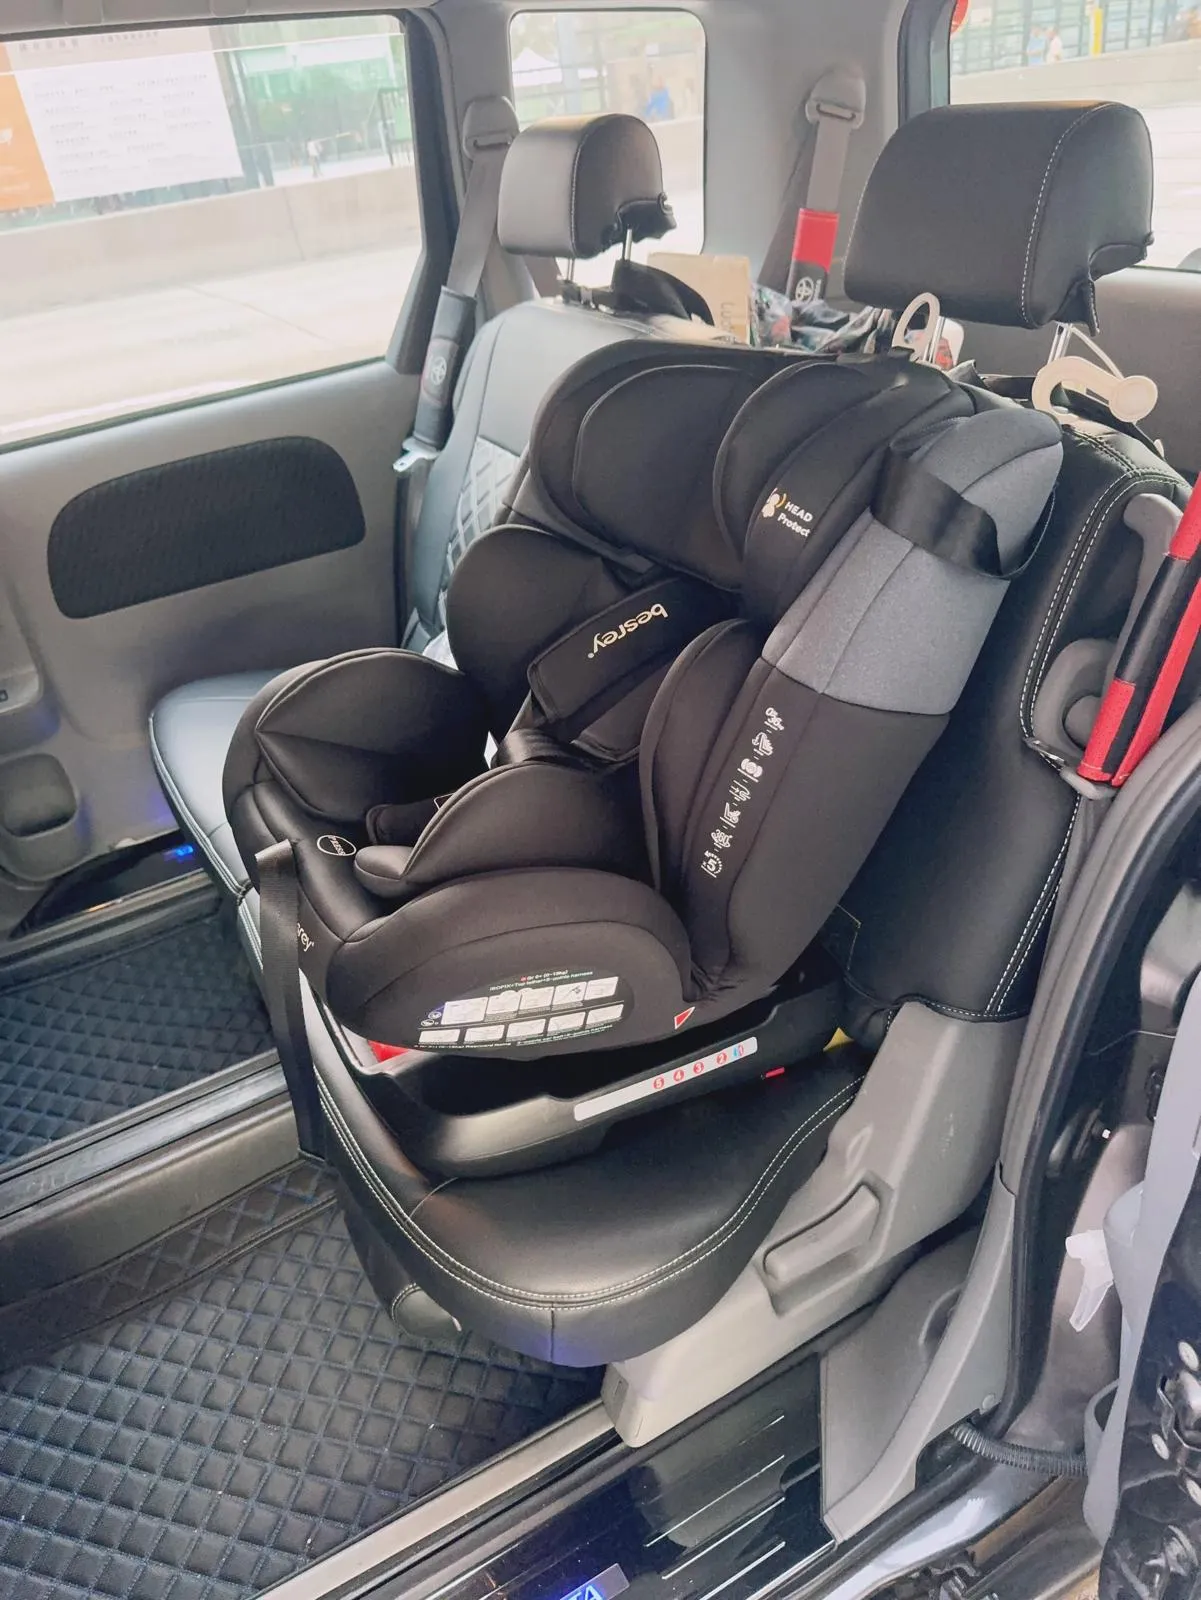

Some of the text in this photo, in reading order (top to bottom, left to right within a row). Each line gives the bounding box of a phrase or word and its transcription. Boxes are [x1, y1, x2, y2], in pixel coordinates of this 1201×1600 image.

[785, 501, 813, 522] HEAD
[777, 512, 811, 537] Protect
[592, 603, 668, 654] besrey
